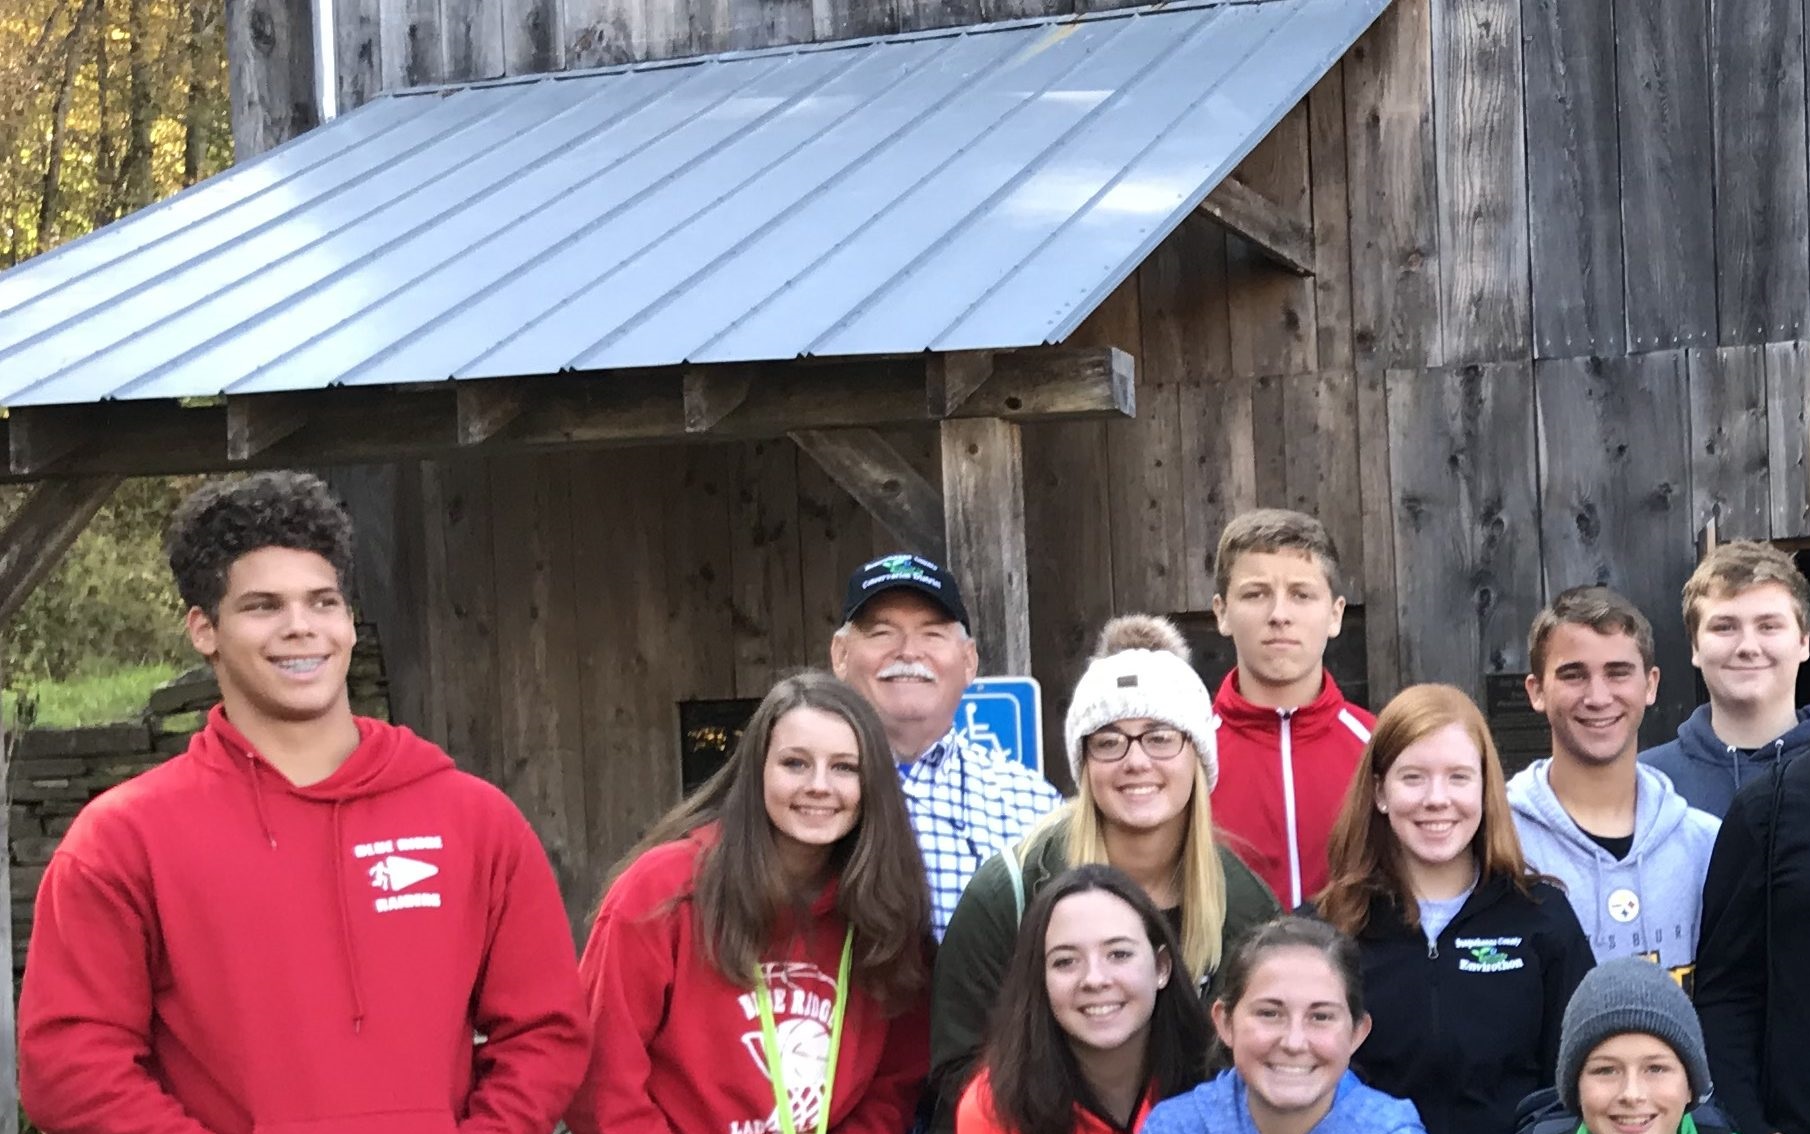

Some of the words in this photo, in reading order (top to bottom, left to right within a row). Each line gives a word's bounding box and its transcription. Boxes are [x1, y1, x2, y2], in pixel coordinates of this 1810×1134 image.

[1459, 958, 1524, 972] Envirothon
[738, 988, 786, 1020] BE
[790, 989, 834, 1028] RIDG
